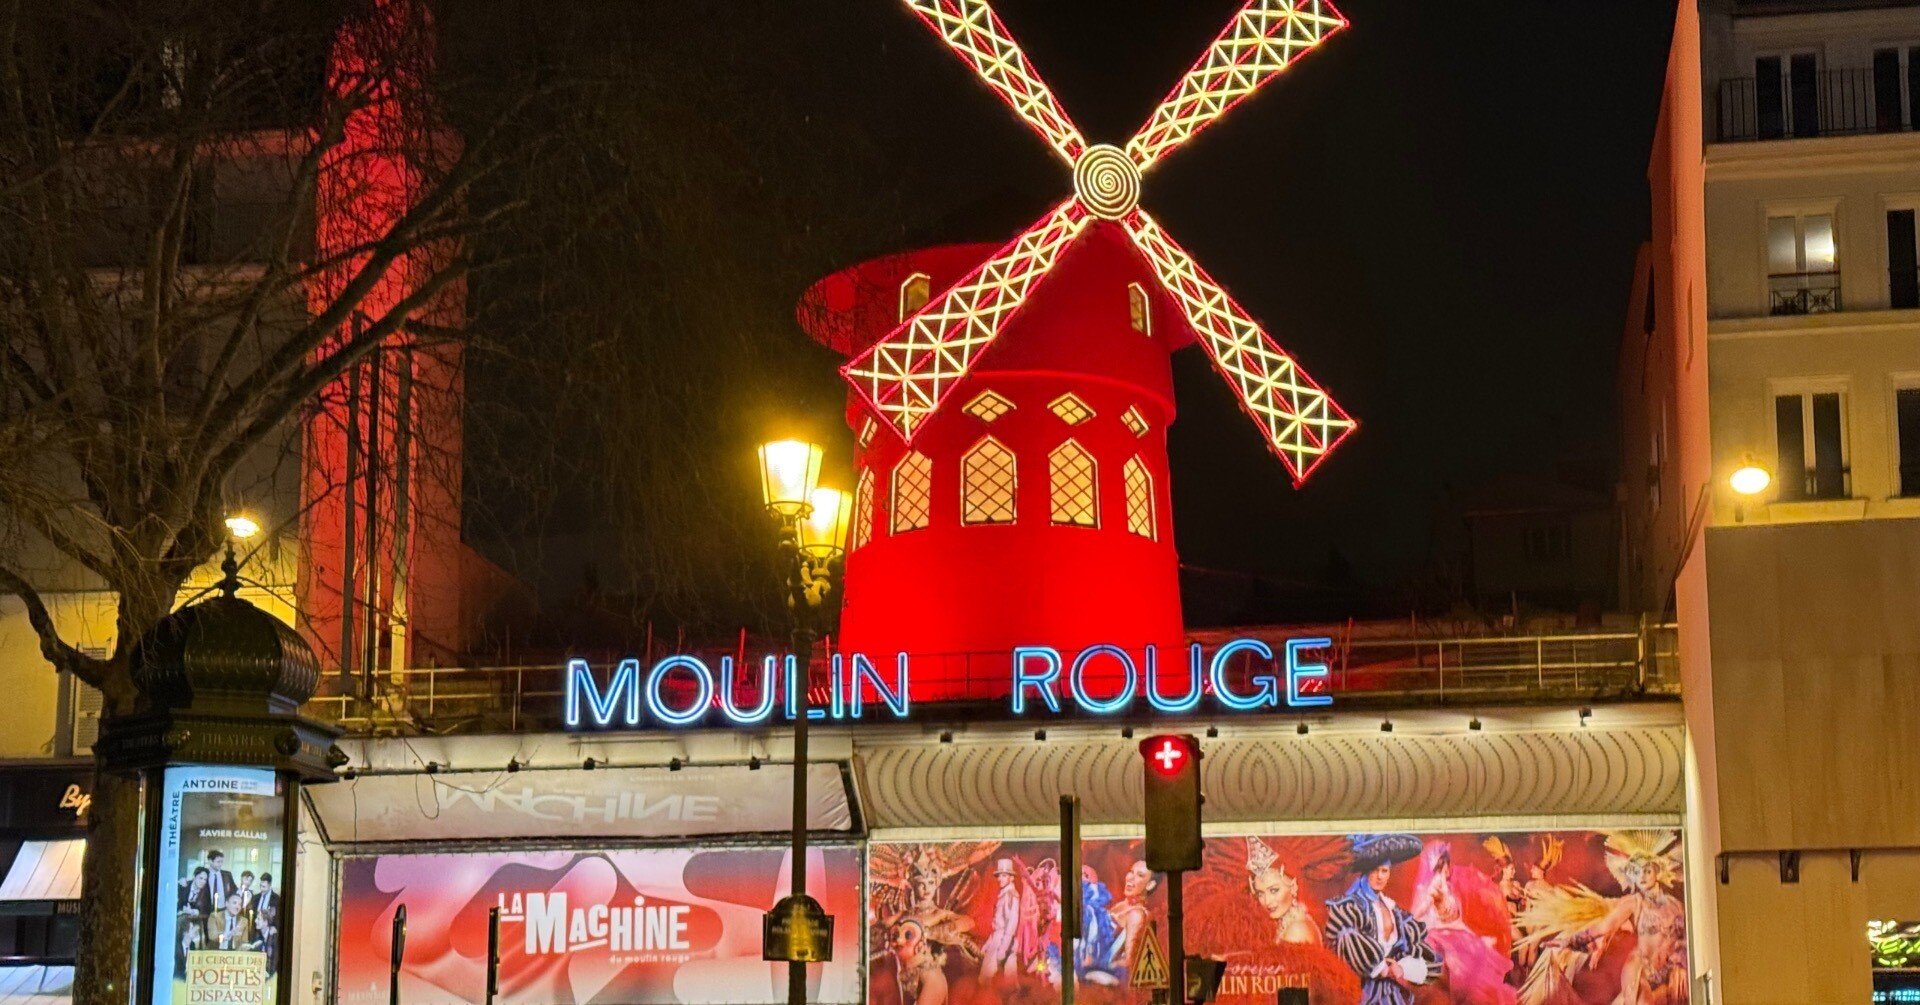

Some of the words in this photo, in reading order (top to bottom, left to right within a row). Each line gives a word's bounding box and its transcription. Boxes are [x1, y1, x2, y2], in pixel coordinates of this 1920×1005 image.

[565, 652, 910, 726] MOULIN
[1011, 638, 1334, 714] ROUGE
[182, 779, 239, 790] ANTOINE
[199, 828, 232, 838] XAVIER
[233, 829, 268, 840] GALLAIS
[498, 892, 523, 915] LA
[609, 954, 622, 964] du
[624, 954, 658, 964] moulin
[661, 954, 690, 965] rouge
[1225, 962, 1285, 976] orever
[1216, 974, 1248, 996] LIN
[190, 989, 262, 1003] DISPARUS
